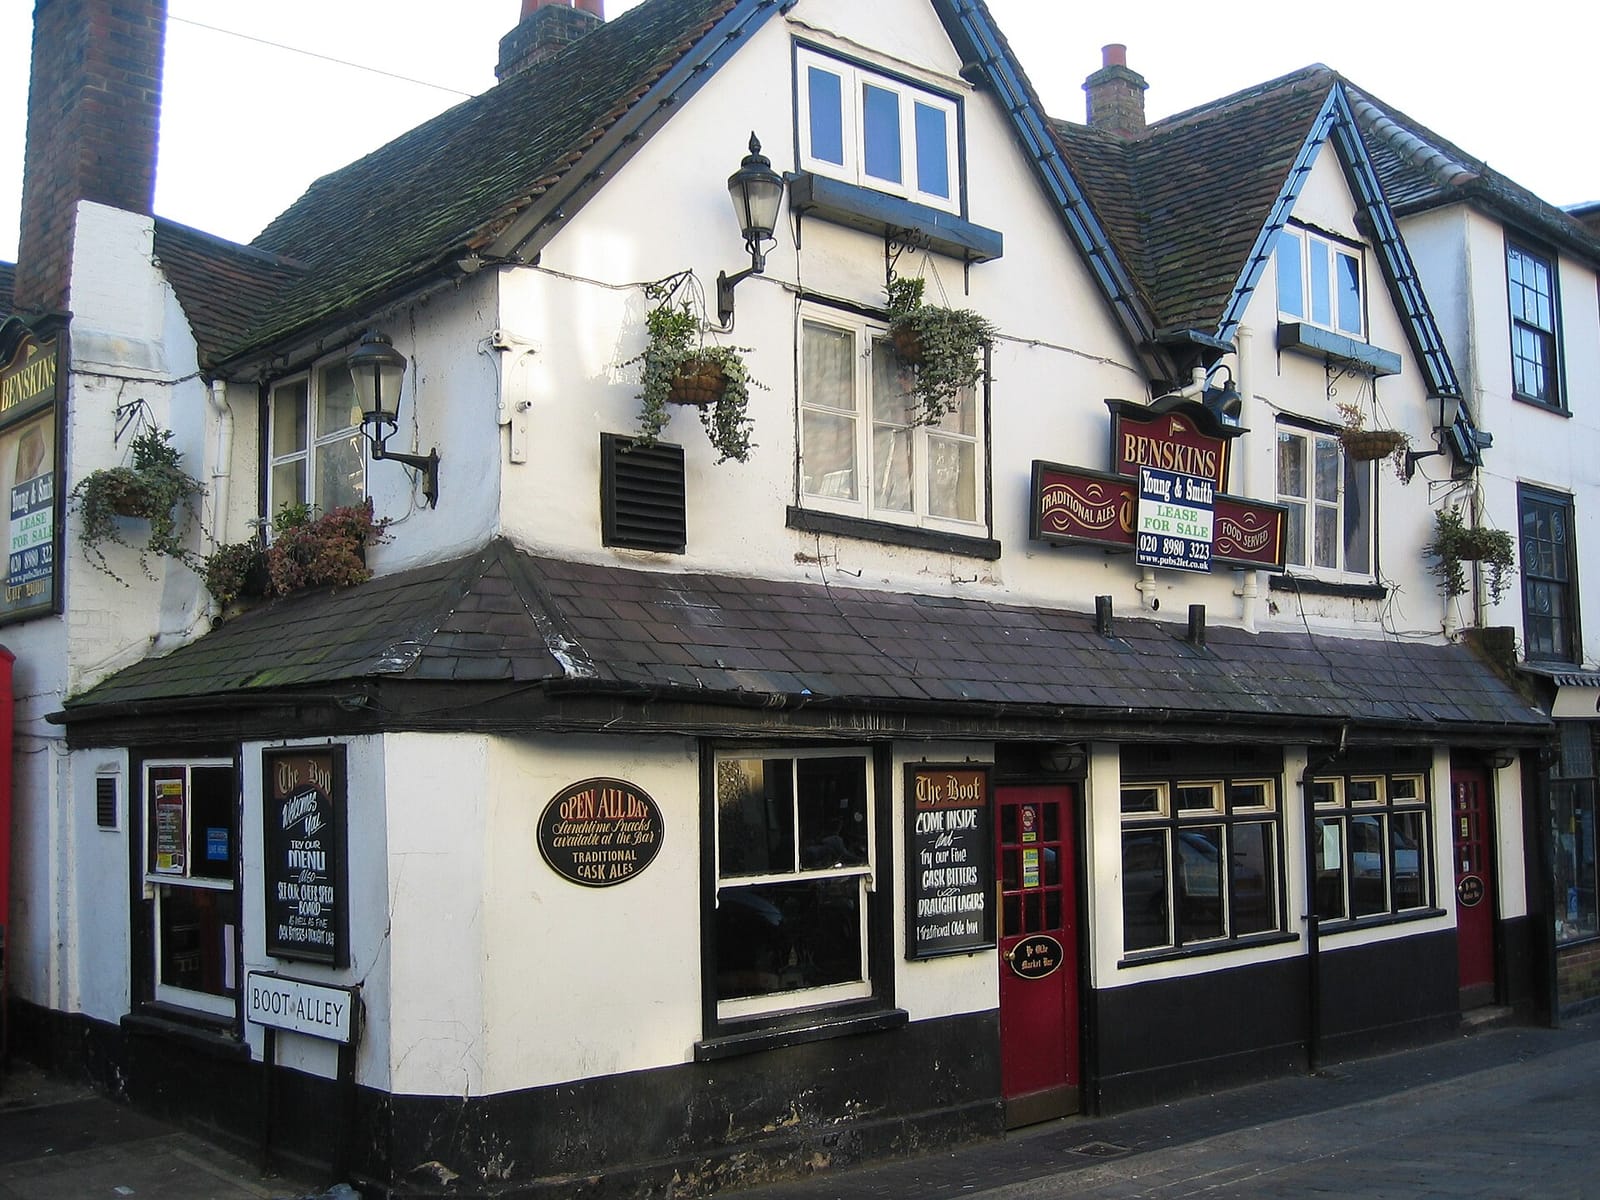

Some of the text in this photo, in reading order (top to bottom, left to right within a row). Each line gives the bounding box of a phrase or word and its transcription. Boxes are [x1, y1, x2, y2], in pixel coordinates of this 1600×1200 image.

[1, 352, 56, 411] BENSKINS
[1124, 432, 1216, 478] BENSKINS
[1142, 470, 1213, 504] Young & Smith
[1041, 490, 1095, 523] TRADITIONAL
[1096, 505, 1116, 523] ALES
[1157, 505, 1198, 522] LEASE
[20, 512, 47, 532] LEASE
[1144, 517, 1208, 538] FOR SALE
[13, 526, 53, 550] FOR SALE
[1222, 522, 1269, 547] FOOD SERVED
[41, 544, 53, 564] 322
[1140, 534, 1210, 560] 020 8980 3223
[1140, 554, 1209, 570] www.pubs2let.co.uk
[278, 760, 332, 795] The Boo
[915, 774, 980, 805] The Boot
[560, 788, 649, 820] OPEN ALL DAY
[551, 818, 652, 835] Lunchtime Snacks
[915, 809, 978, 833] COME INSIDE
[304, 840, 321, 850] OUR
[552, 830, 654, 847] available at the Bar
[288, 850, 326, 871] MENU
[572, 849, 637, 863] TRADITIONAL
[577, 863, 634, 880] CASK ALES
[923, 866, 978, 889] CASK BITTERS
[278, 881, 288, 900] SEE
[318, 885, 334, 903] SPECI
[298, 900, 321, 916] BOARD
[918, 892, 985, 917] DRAUGHT LAGERS
[253, 988, 343, 1027] BOOT ALLEY
